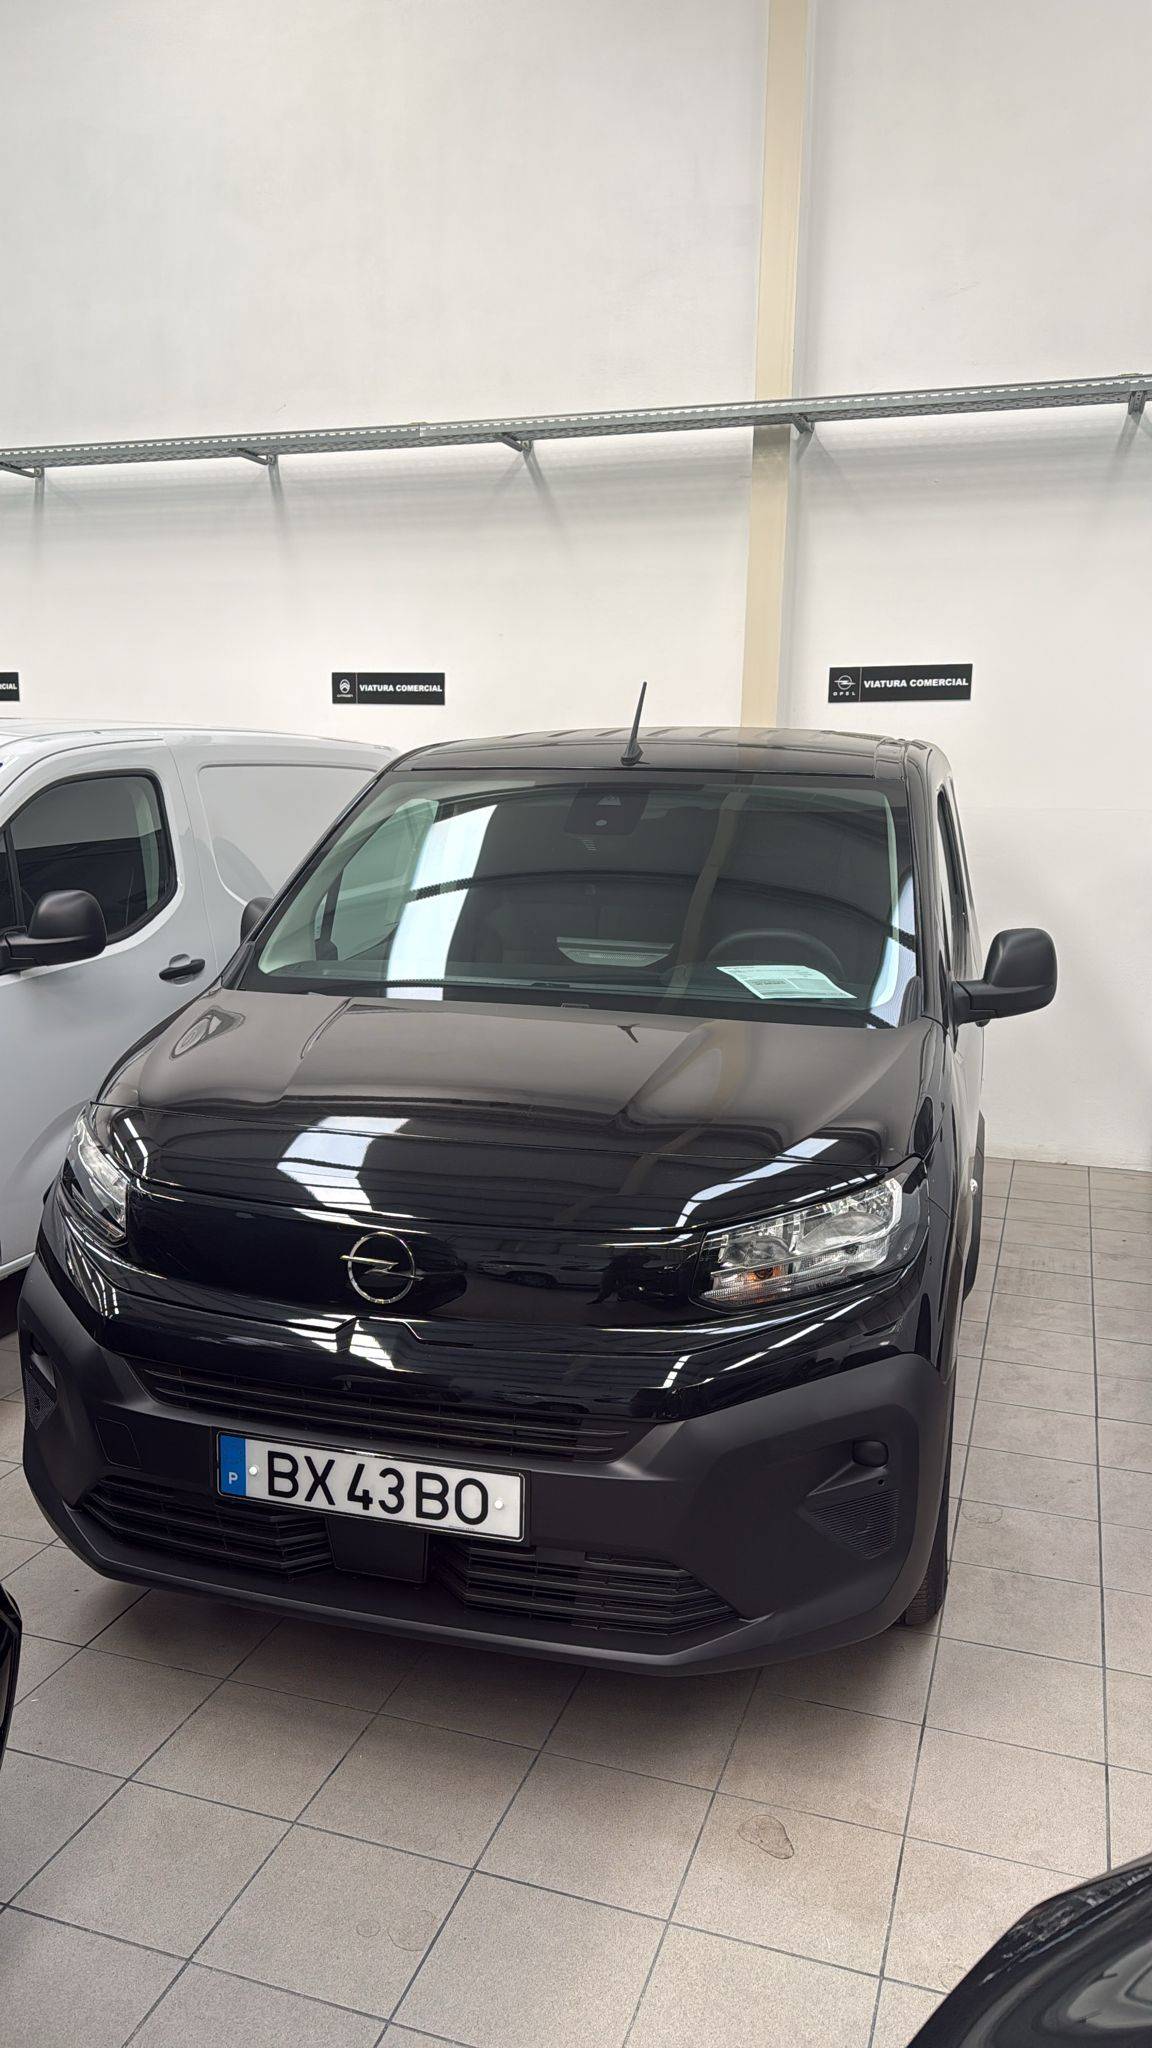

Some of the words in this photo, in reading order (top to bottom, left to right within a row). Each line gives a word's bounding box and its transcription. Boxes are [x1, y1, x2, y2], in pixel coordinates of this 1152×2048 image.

[359, 684, 395, 692] VIATURA
[395, 684, 443, 692] COMERCIAL
[863, 679, 907, 688] VIATURA
[909, 678, 969, 687] COMERCIAL
[228, 1471, 238, 1485] P
